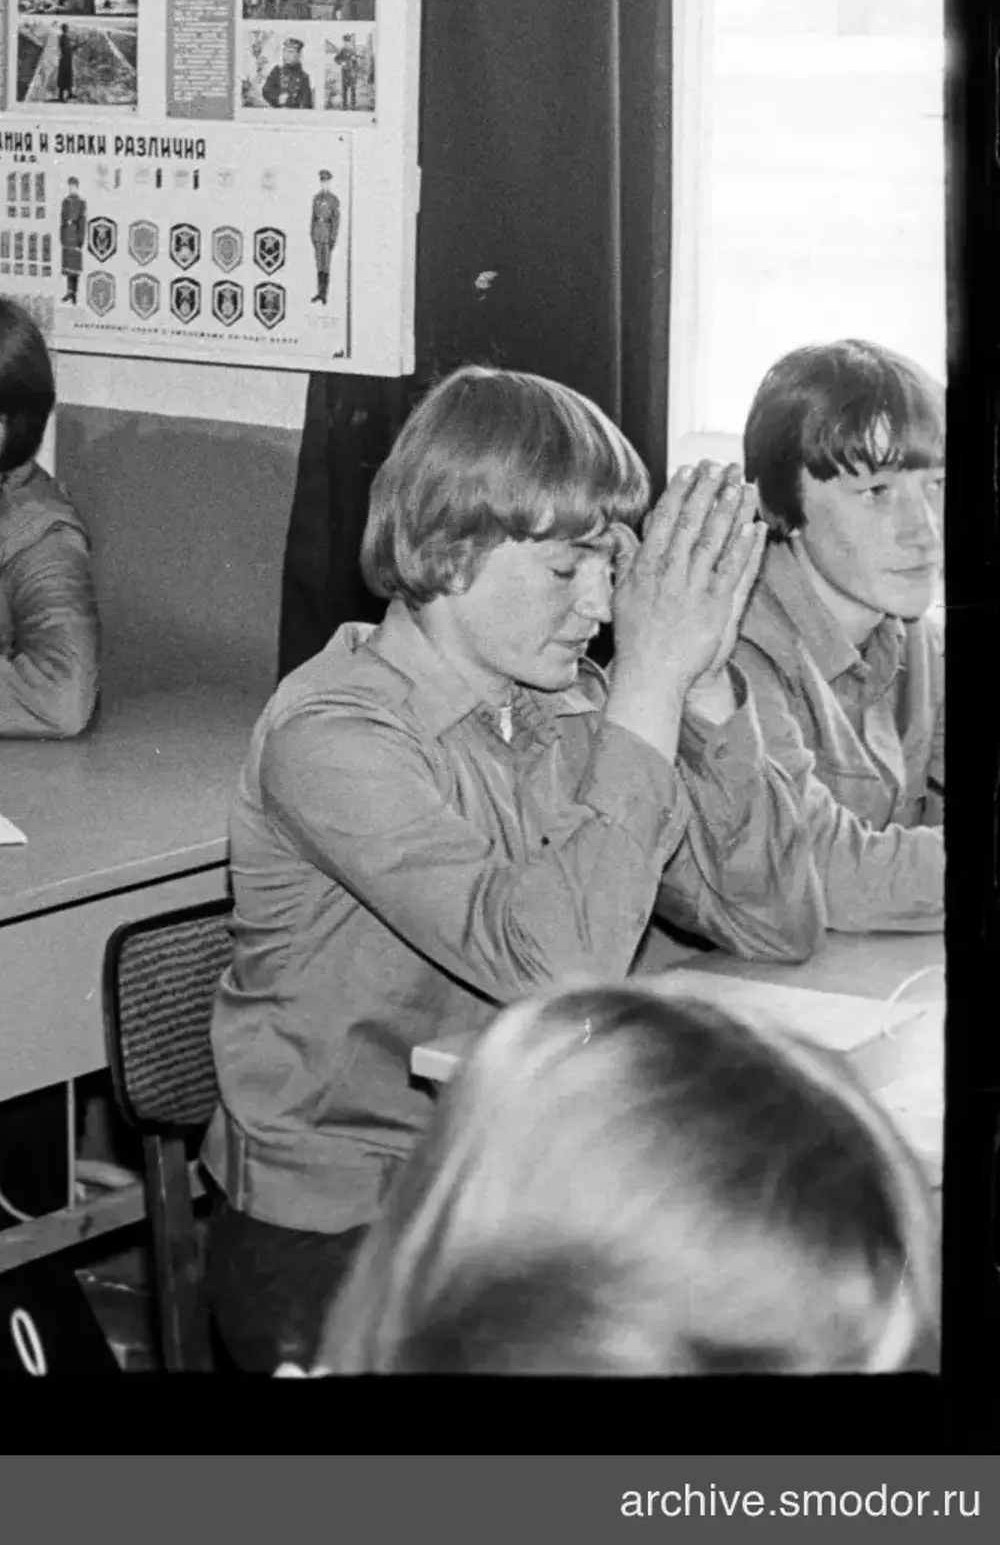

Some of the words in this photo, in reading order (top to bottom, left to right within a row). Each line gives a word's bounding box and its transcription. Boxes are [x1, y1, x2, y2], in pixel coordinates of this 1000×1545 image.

[40, 133, 48, 152] И
[55, 134, 106, 154] ЗНАКИ
[115, 136, 205, 159] РАЗЛИЧИЯ
